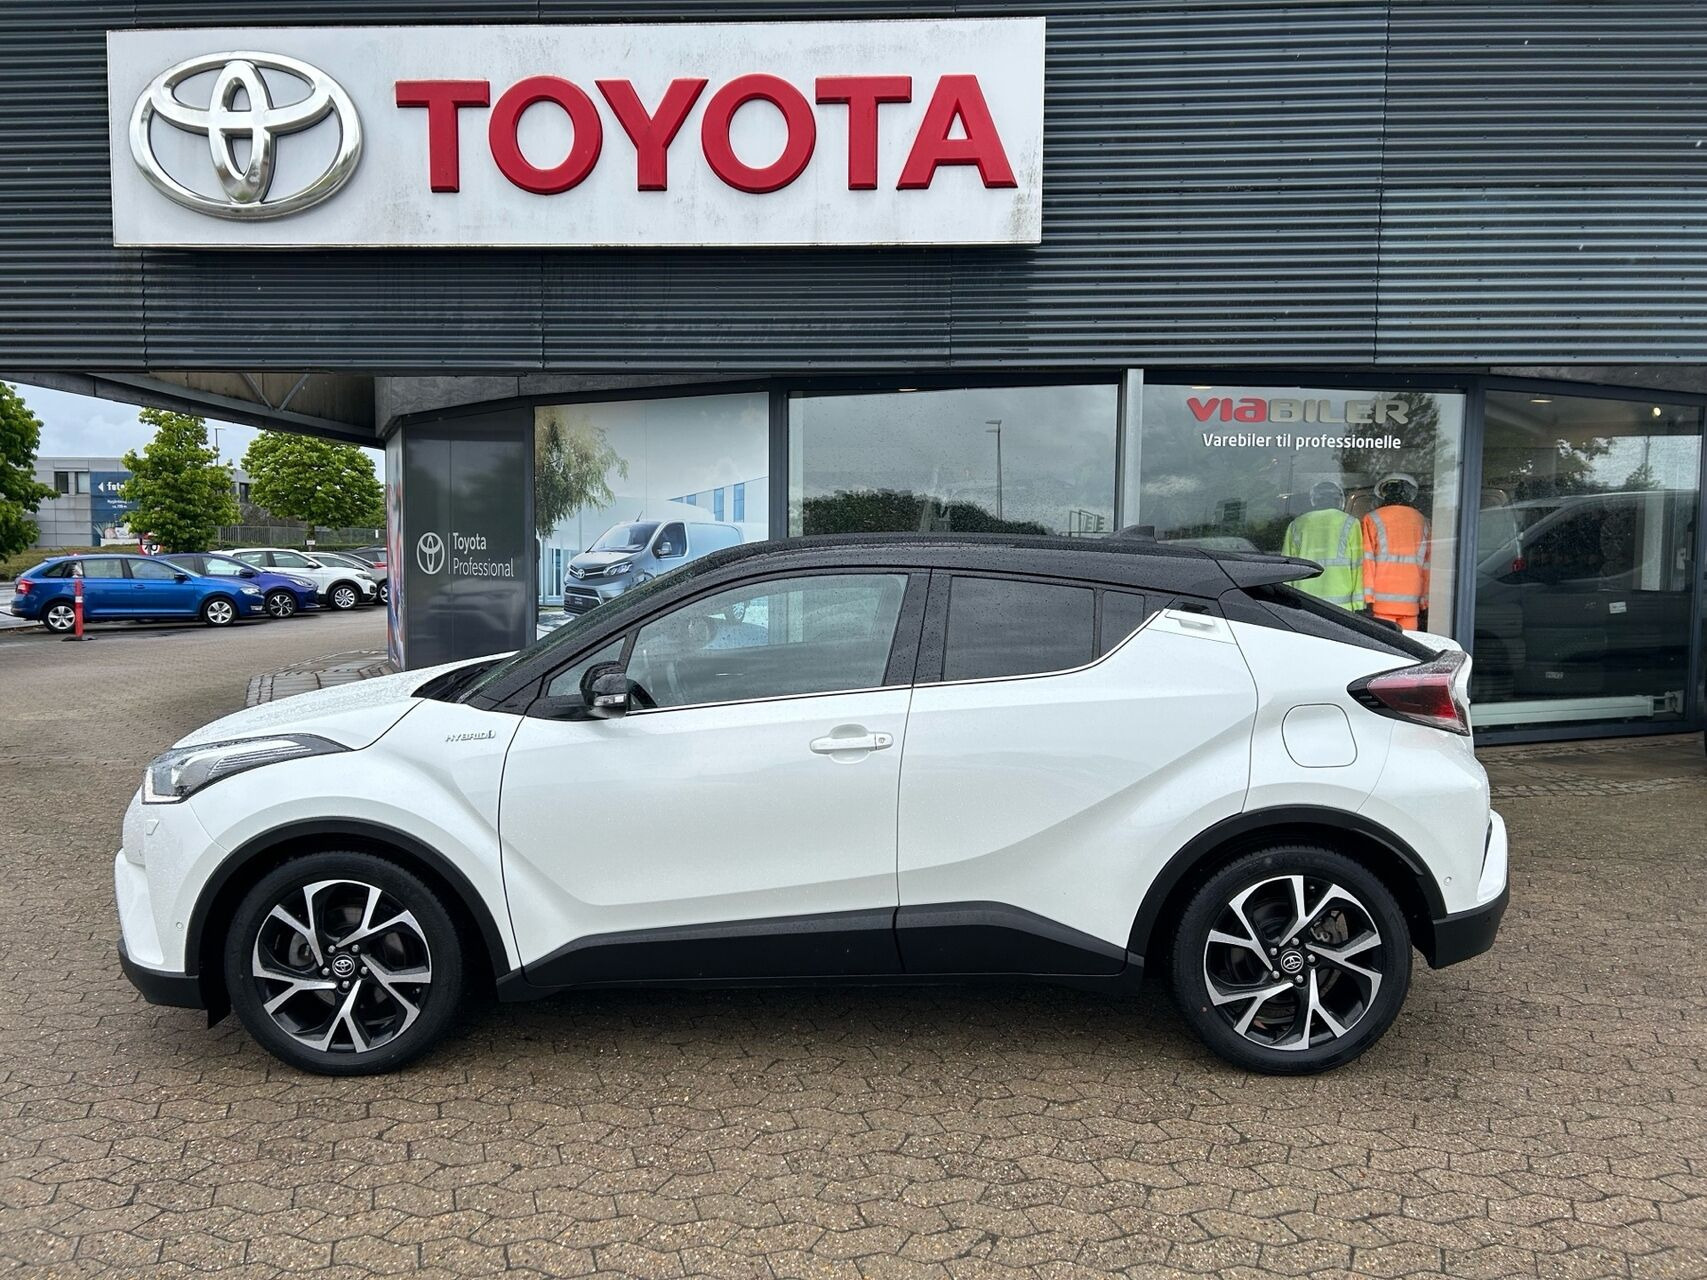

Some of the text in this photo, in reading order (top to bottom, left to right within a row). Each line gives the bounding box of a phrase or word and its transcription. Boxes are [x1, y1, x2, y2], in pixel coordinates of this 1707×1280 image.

[395, 74, 1018, 195] TOYOTA
[1203, 433, 1401, 451] Varebiler til professionelle
[453, 532, 487, 555] Toyota
[453, 556, 514, 577] Professional
